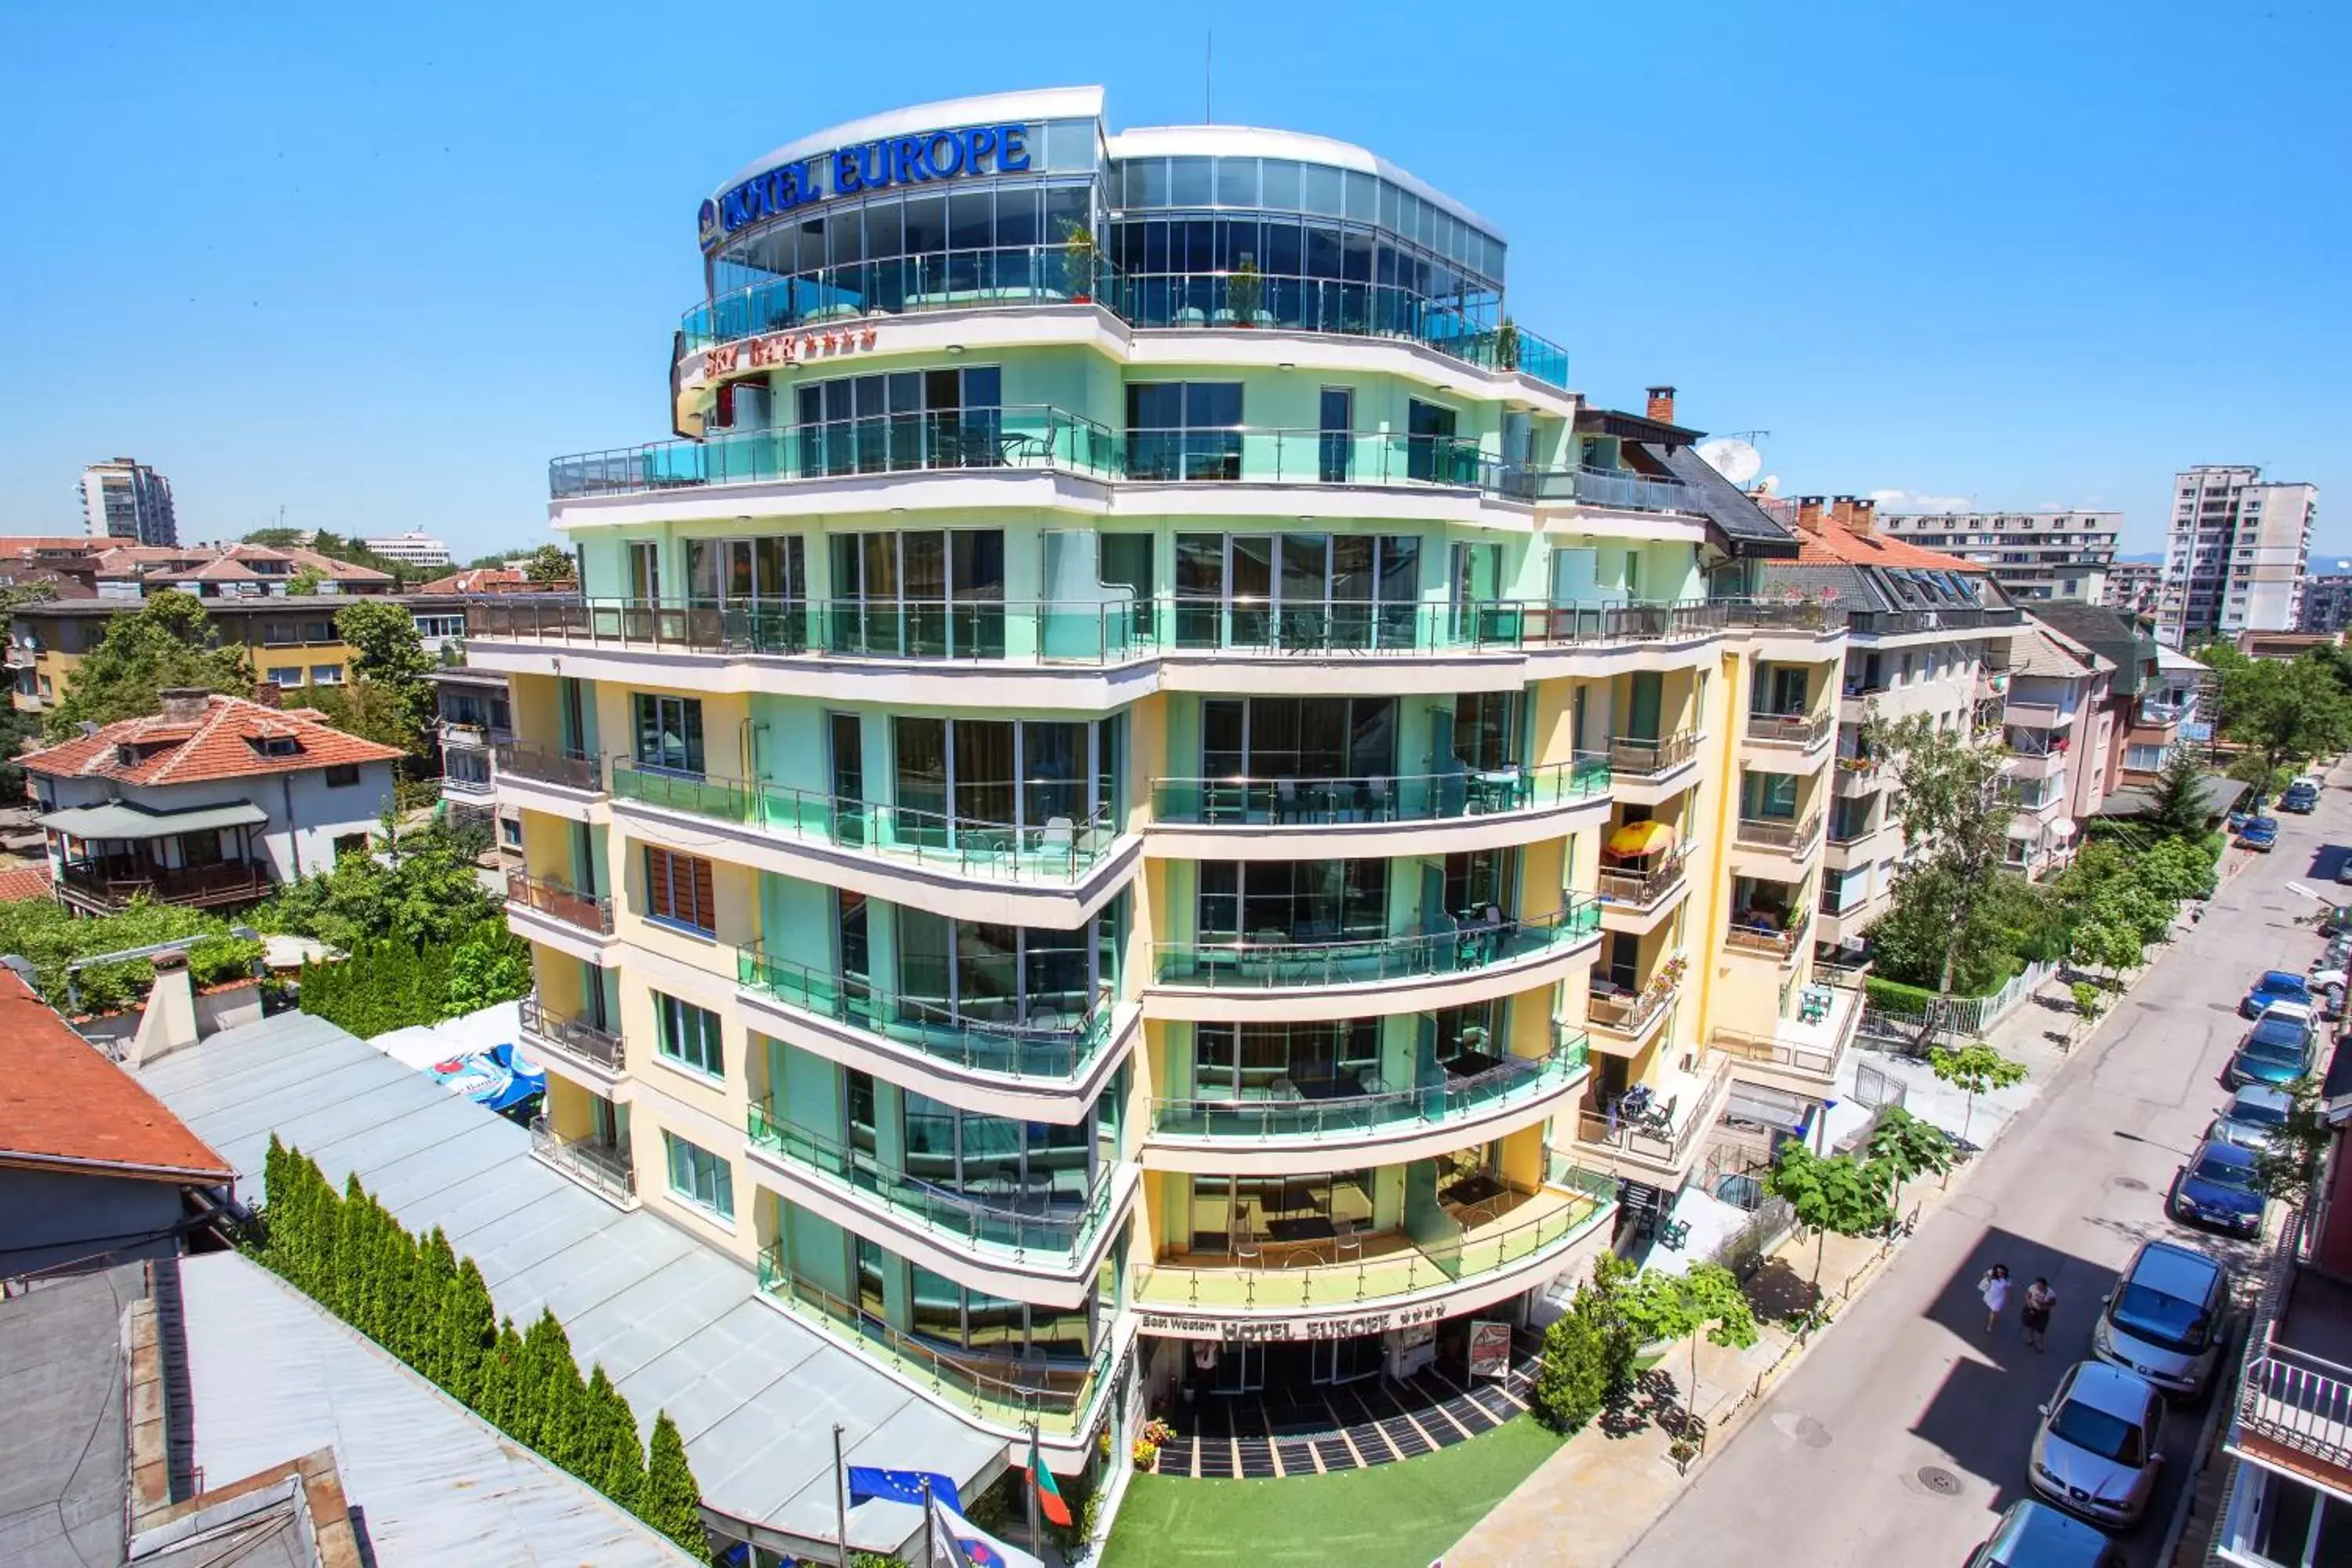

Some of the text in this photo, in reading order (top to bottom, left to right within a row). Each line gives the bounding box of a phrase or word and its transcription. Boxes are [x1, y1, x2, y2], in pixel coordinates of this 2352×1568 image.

[721, 124, 1029, 232] HOTEL EUROPE
[704, 335, 797, 379] SKY BAR
[1171, 1318, 1217, 1332] Western
[1221, 1321, 1295, 1341] HOTEL
[1307, 1313, 1392, 1339] EUROPE
